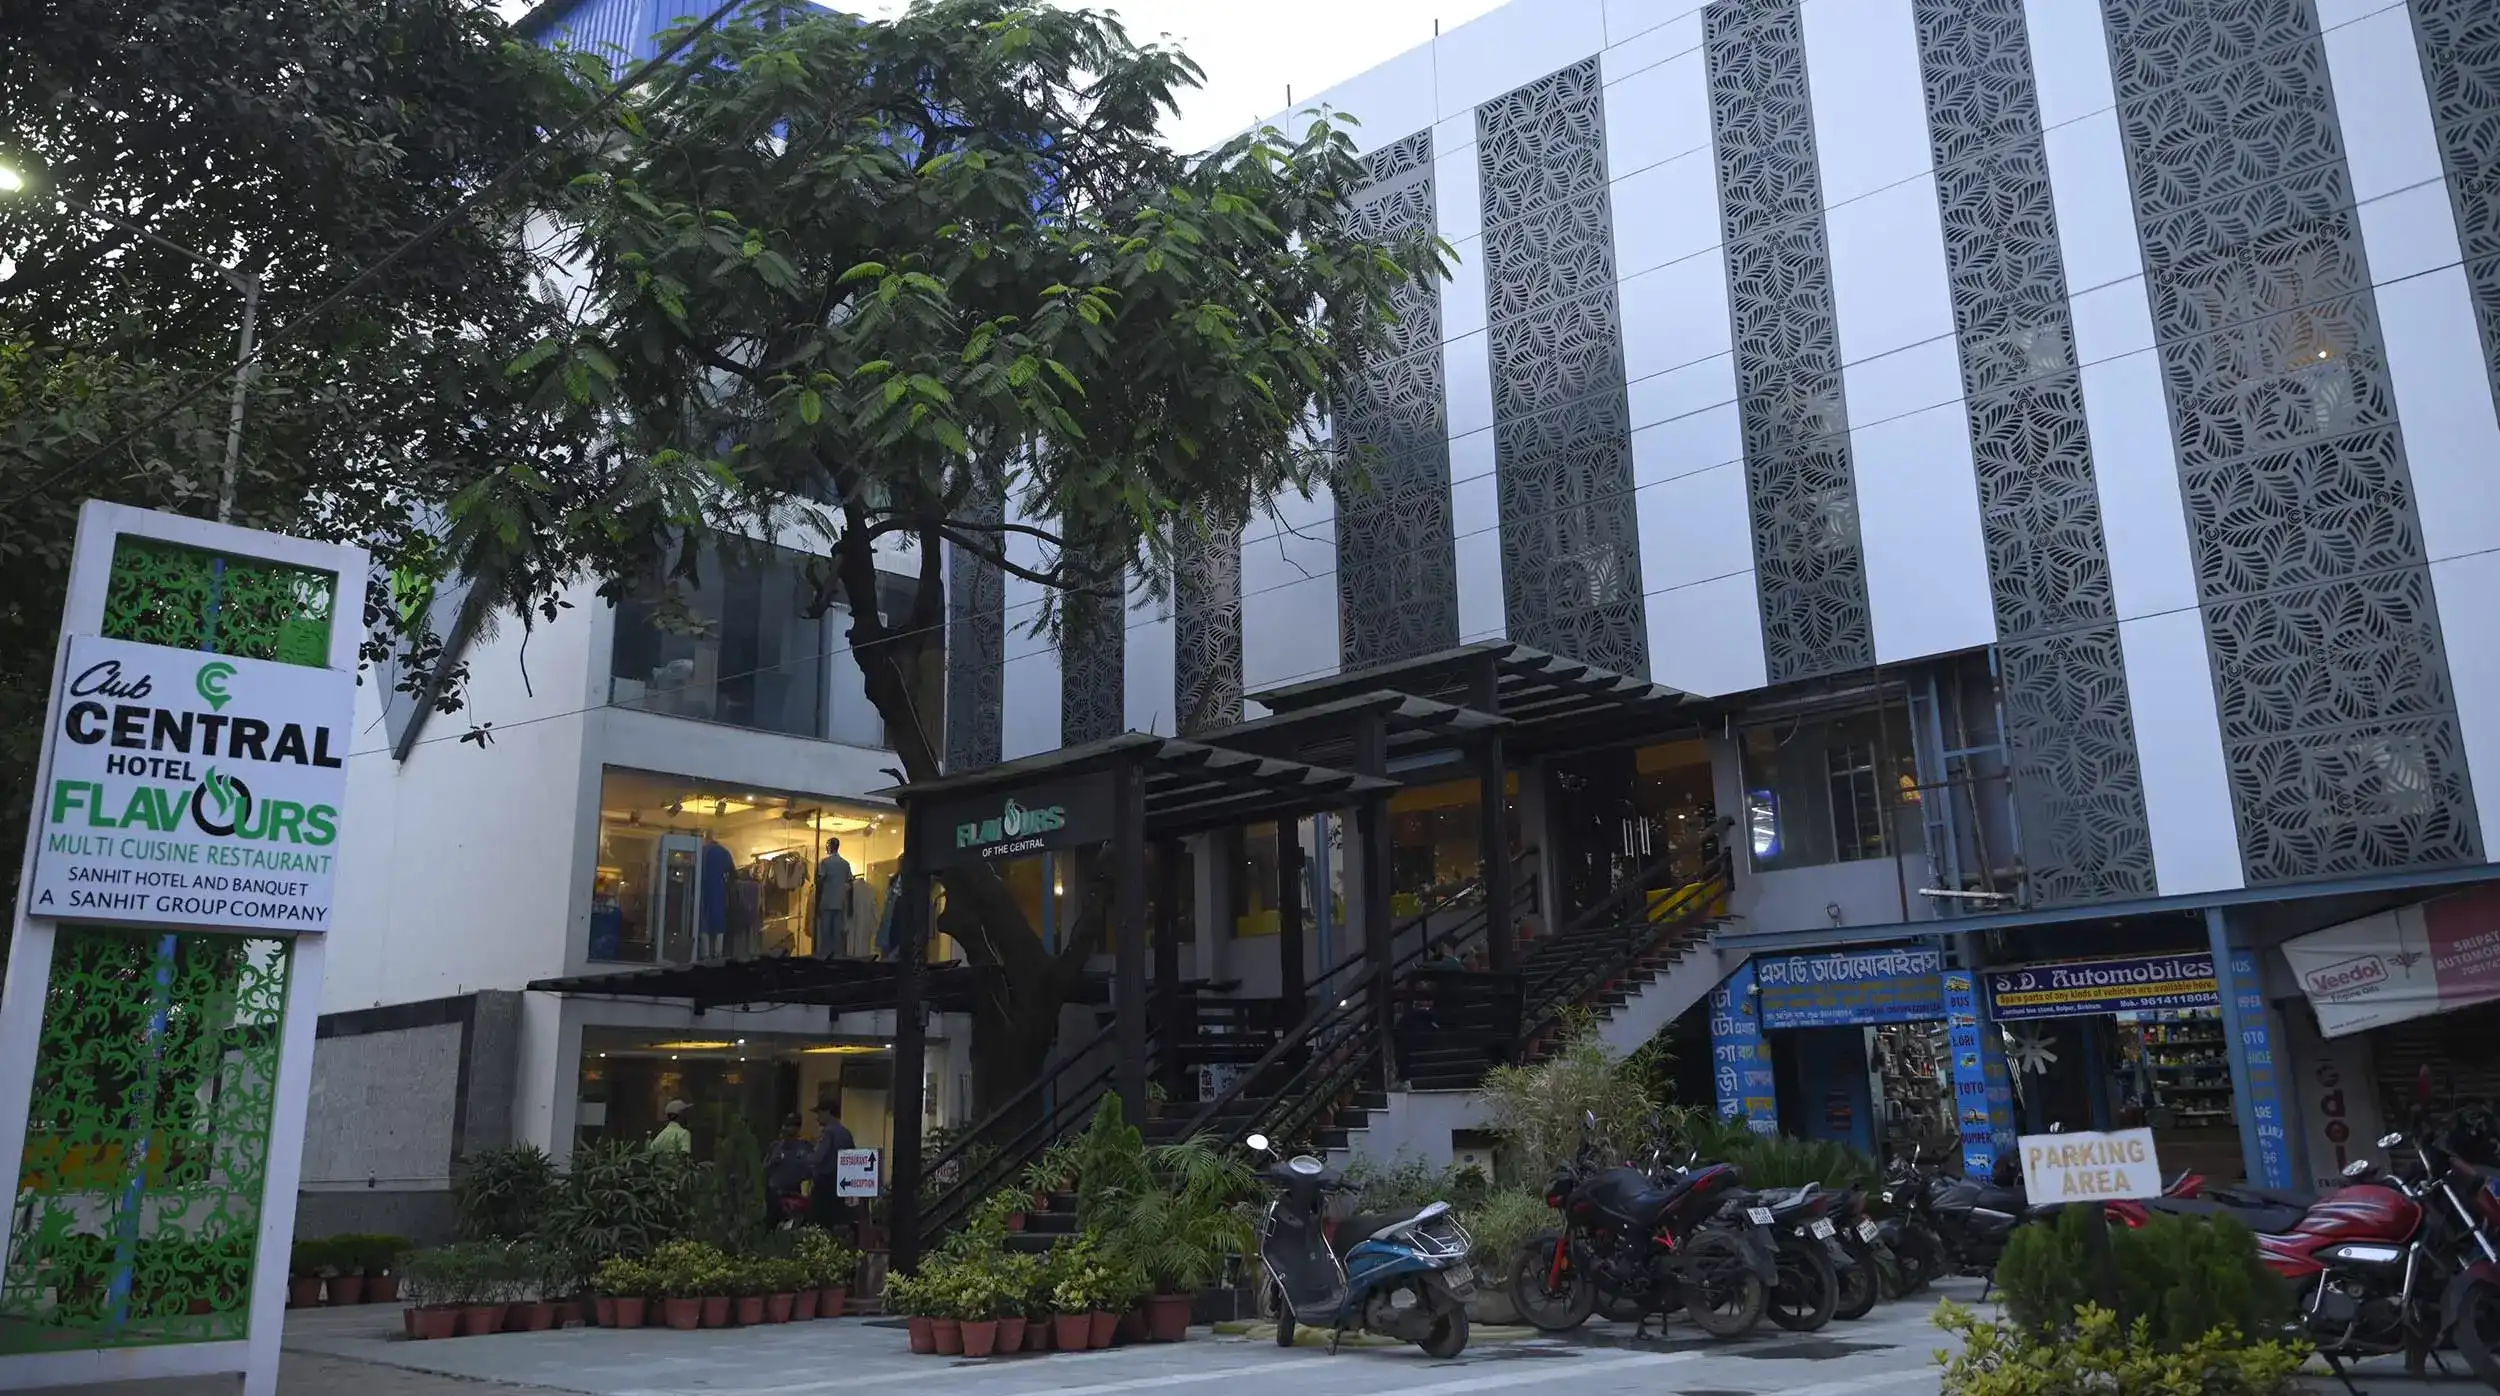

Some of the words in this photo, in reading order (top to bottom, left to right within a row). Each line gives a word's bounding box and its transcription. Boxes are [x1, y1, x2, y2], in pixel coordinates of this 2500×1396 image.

[70, 660, 152, 699] Club
[65, 701, 342, 768] CENTRAL
[106, 754, 196, 782] HOTEL
[51, 768, 338, 846] FLAVOURS
[48, 833, 113, 857] MULTI
[120, 840, 199, 864] CUISINE
[207, 845, 332, 874] RESTAURANT
[982, 847, 992, 857] OF
[993, 844, 1009, 856] THE
[1010, 838, 1045, 853] CENTRAL
[68, 866, 133, 884] SANHIT
[136, 870, 188, 888] HOTEL
[192, 875, 228, 891] AND
[233, 878, 309, 897] BANQUET
[39, 889, 54, 905] A
[69, 890, 149, 912] SANHIT
[156, 896, 227, 916] GROUP
[230, 900, 329, 923] COMPANY
[2453, 929, 2500, 952] SRIPAT
[1996, 971, 2044, 992] S.D.
[2052, 960, 2214, 988] Automobiles
[2312, 961, 2383, 992] Veedol
[1951, 997, 1970, 1007] BUS
[2001, 994, 2023, 1004] Spare
[2024, 992, 2044, 1003] parts
[2045, 991, 2053, 1000] of
[2054, 991, 2068, 1001] any
[2070, 988, 2091, 999] kinds
[2094, 987, 2102, 997] of
[2103, 986, 2137, 997] vehicles
[2140, 986, 2152, 994] are
[2154, 982, 2191, 993] available
[2140, 992, 2218, 1006] 9614118084
[2242, 1031, 2264, 1044] OTO
[1959, 1081, 1984, 1096] TOTO
[2028, 1140, 2145, 1170] PARKING
[2062, 1167, 2132, 1196] AREA
